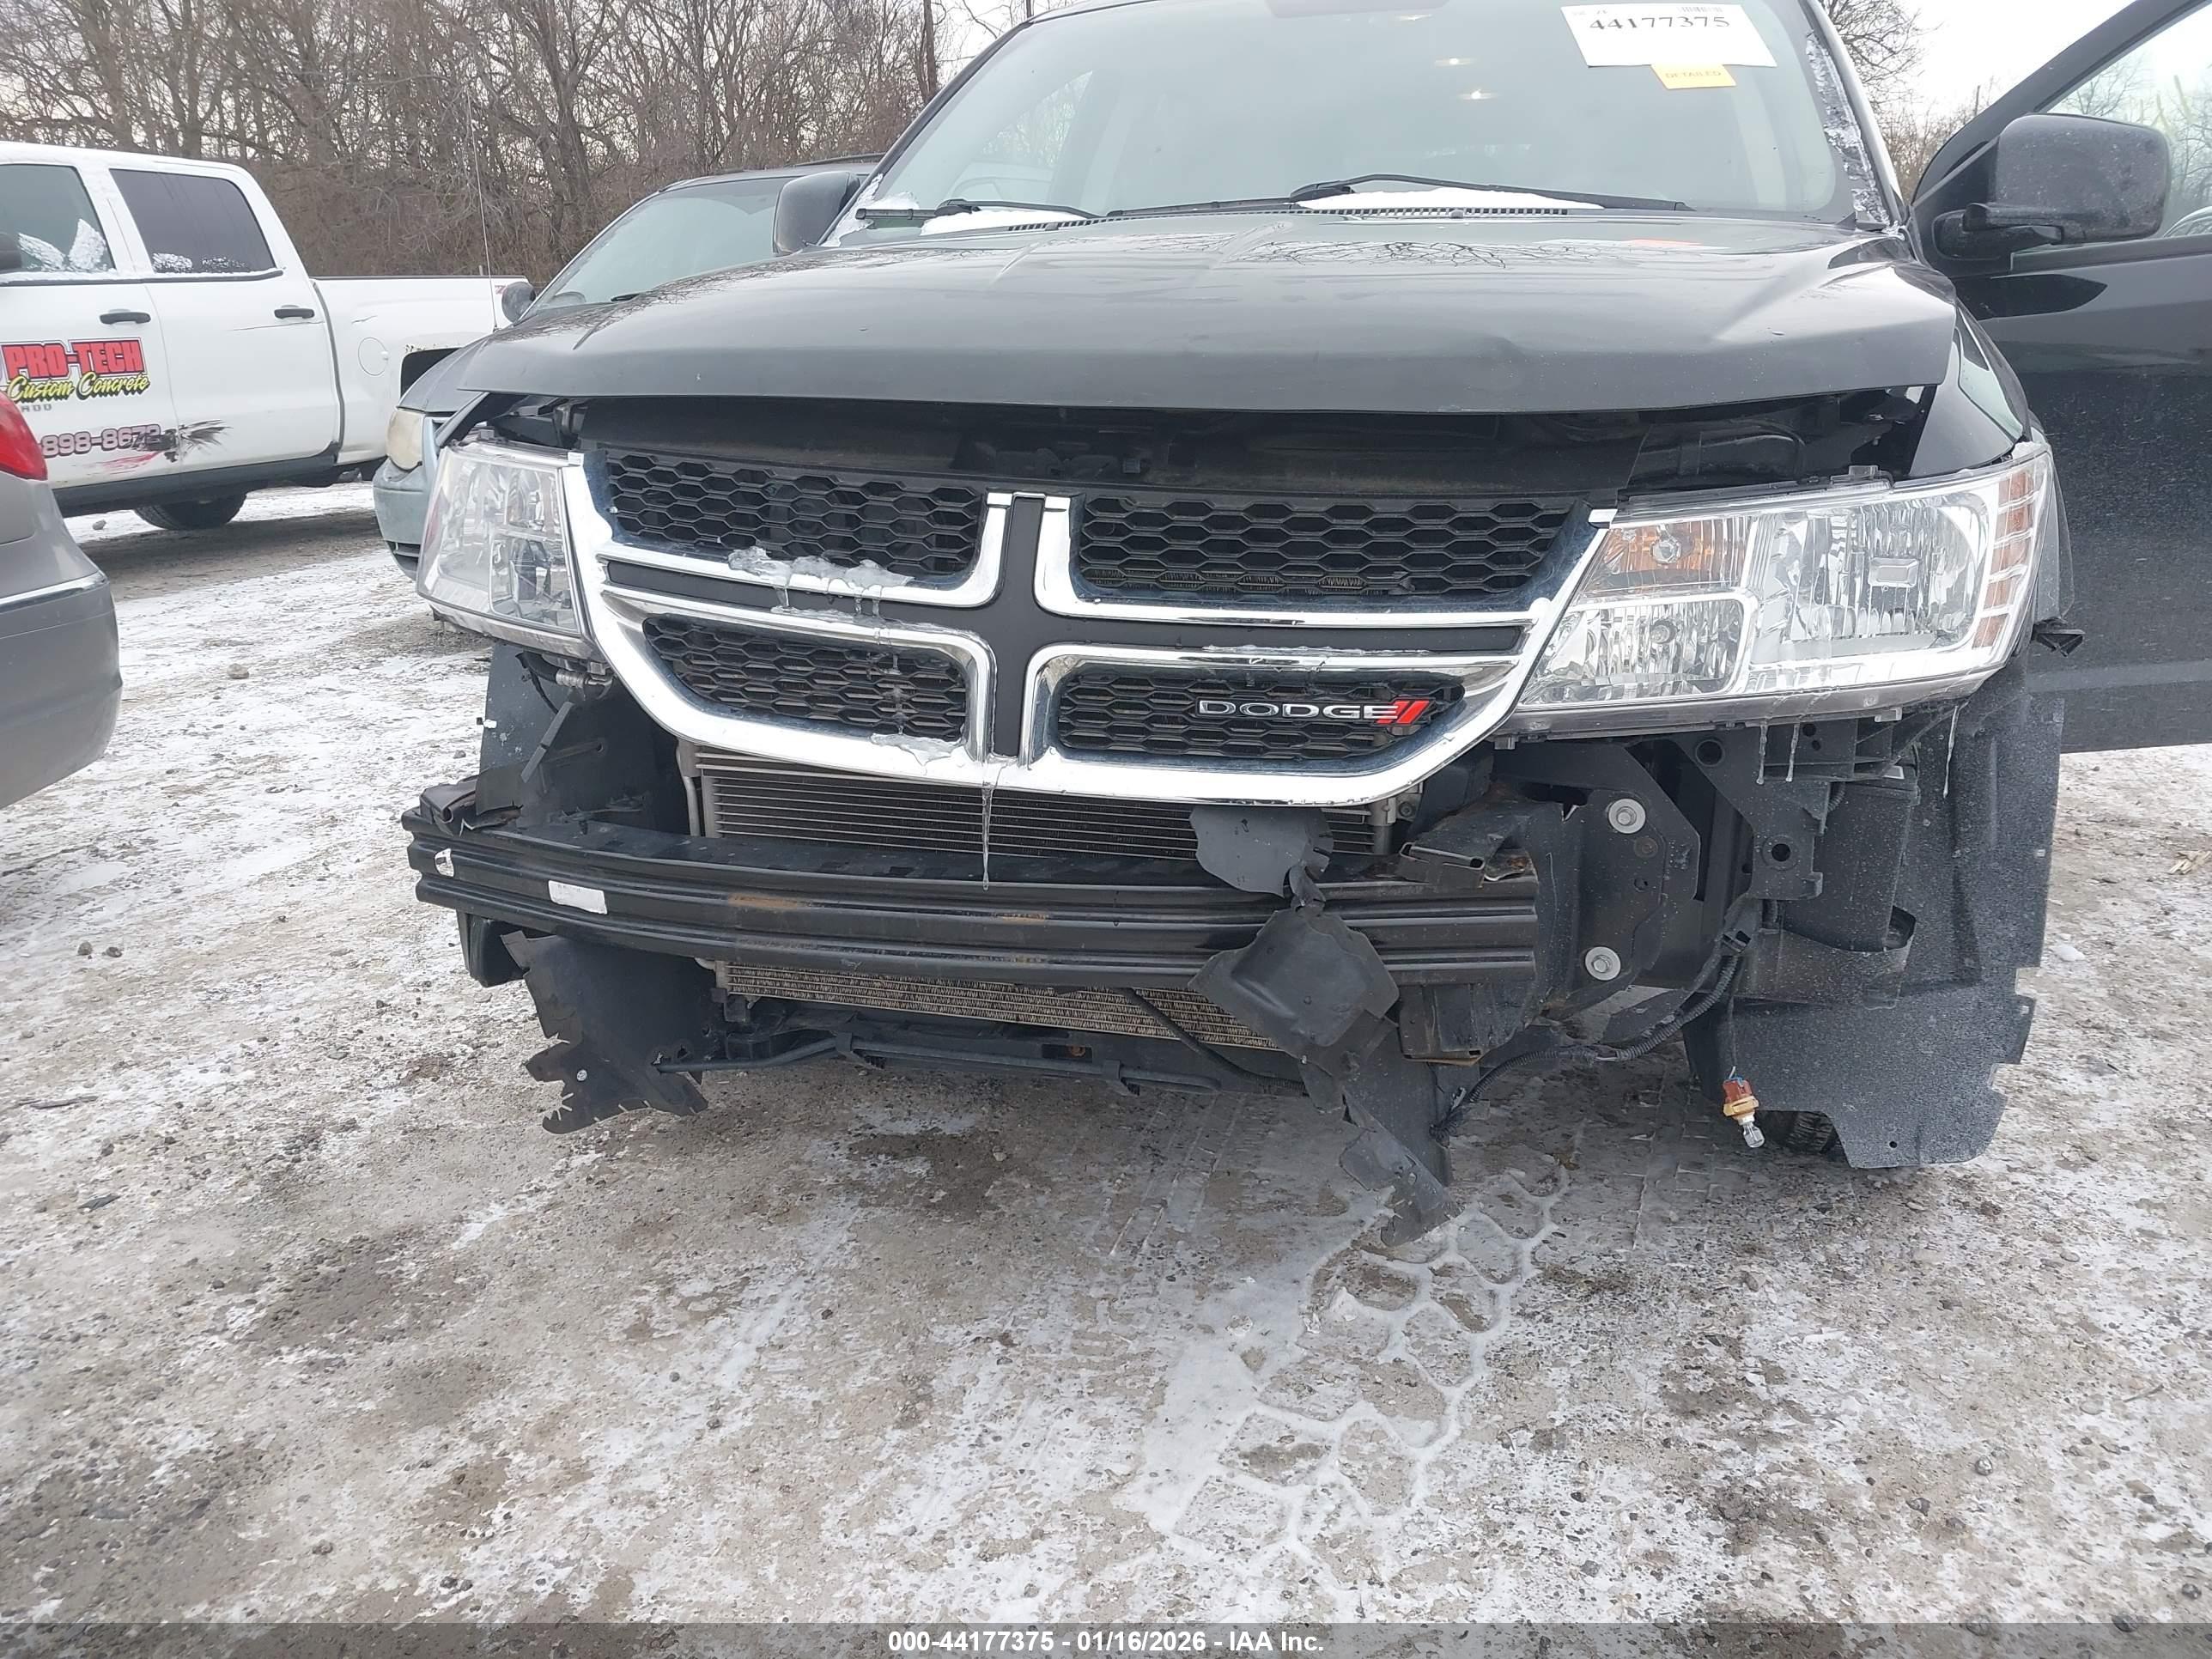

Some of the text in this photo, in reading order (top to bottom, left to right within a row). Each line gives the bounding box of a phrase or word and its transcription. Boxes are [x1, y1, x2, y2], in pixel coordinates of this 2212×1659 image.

[1589, 16, 1731, 30] 44177375
[1, 340, 145, 380] PRO-TECH
[7, 371, 150, 403] Custom Concrete
[1199, 699, 1400, 720] DODGE
